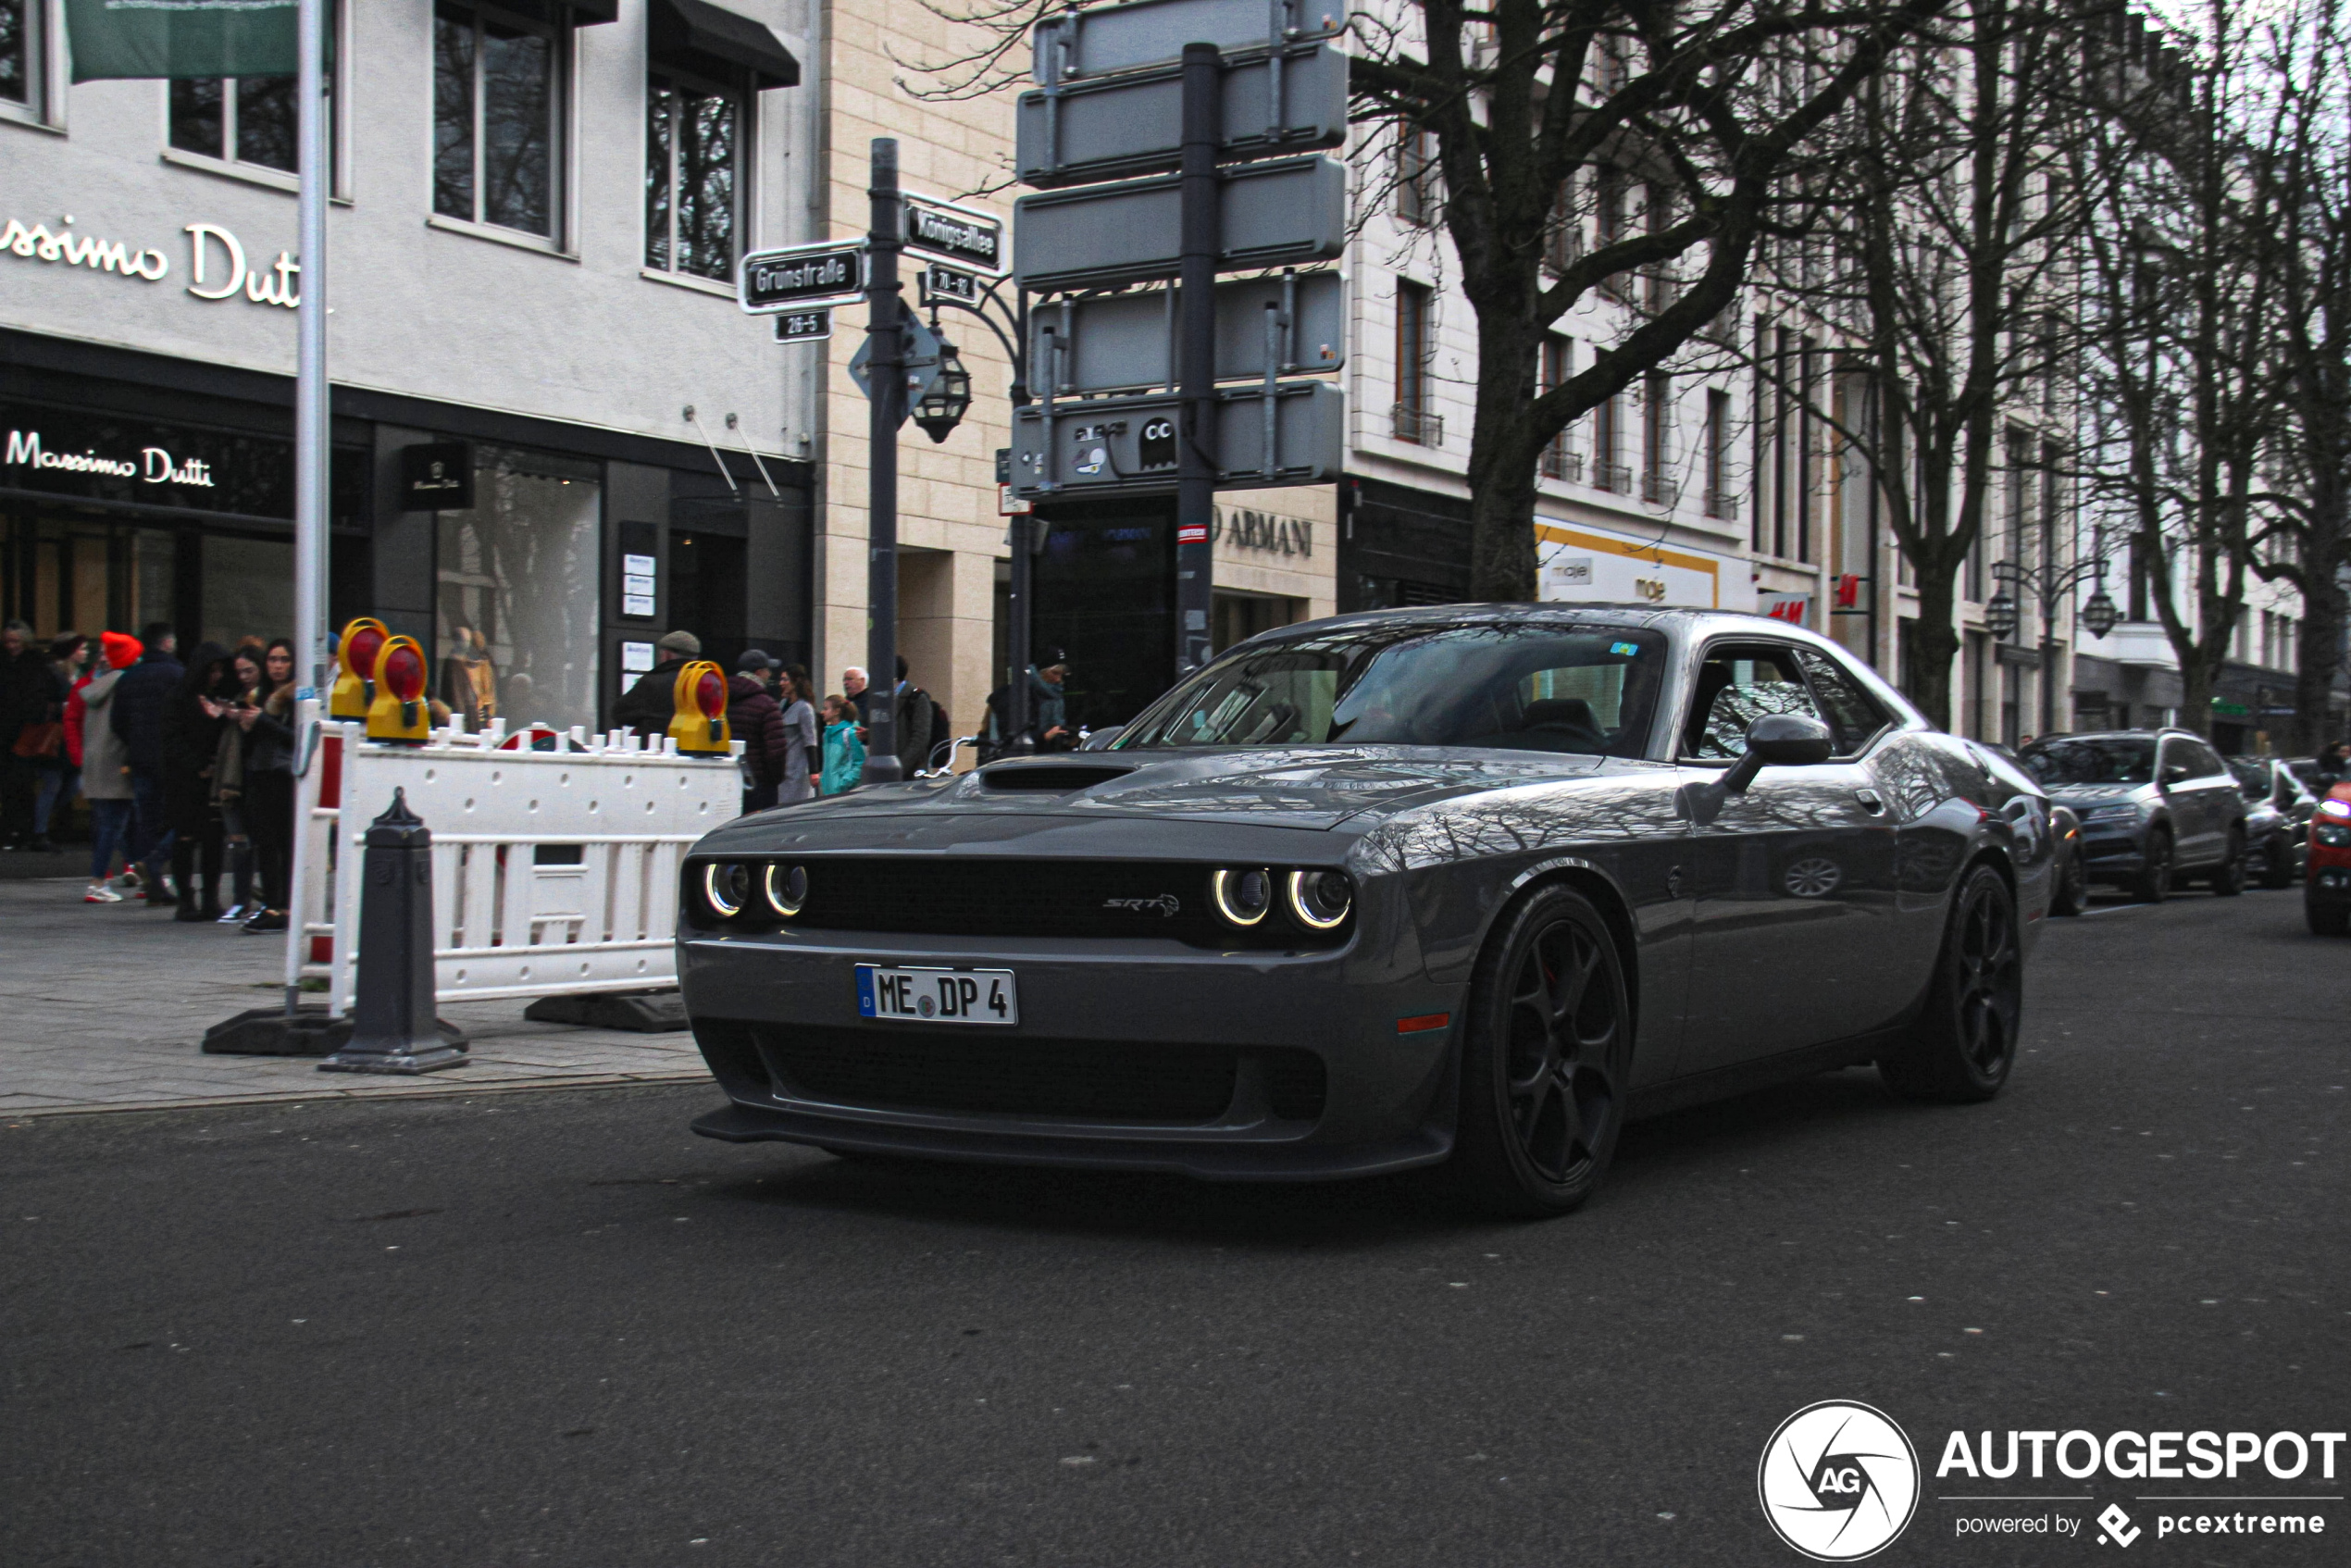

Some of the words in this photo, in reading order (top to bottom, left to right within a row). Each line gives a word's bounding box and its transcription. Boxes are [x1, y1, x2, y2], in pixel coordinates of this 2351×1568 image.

[917, 211, 994, 255] Königsallee
[756, 258, 846, 292] Grünstraße
[6, 430, 136, 477] Massimo
[142, 448, 215, 487] Dutti
[1225, 510, 1312, 557] ARMANI
[1102, 899, 1163, 911] SRT
[863, 996, 872, 1009] D
[877, 974, 916, 1015] ME
[937, 976, 978, 1017] DP
[988, 977, 1008, 1018] 4
